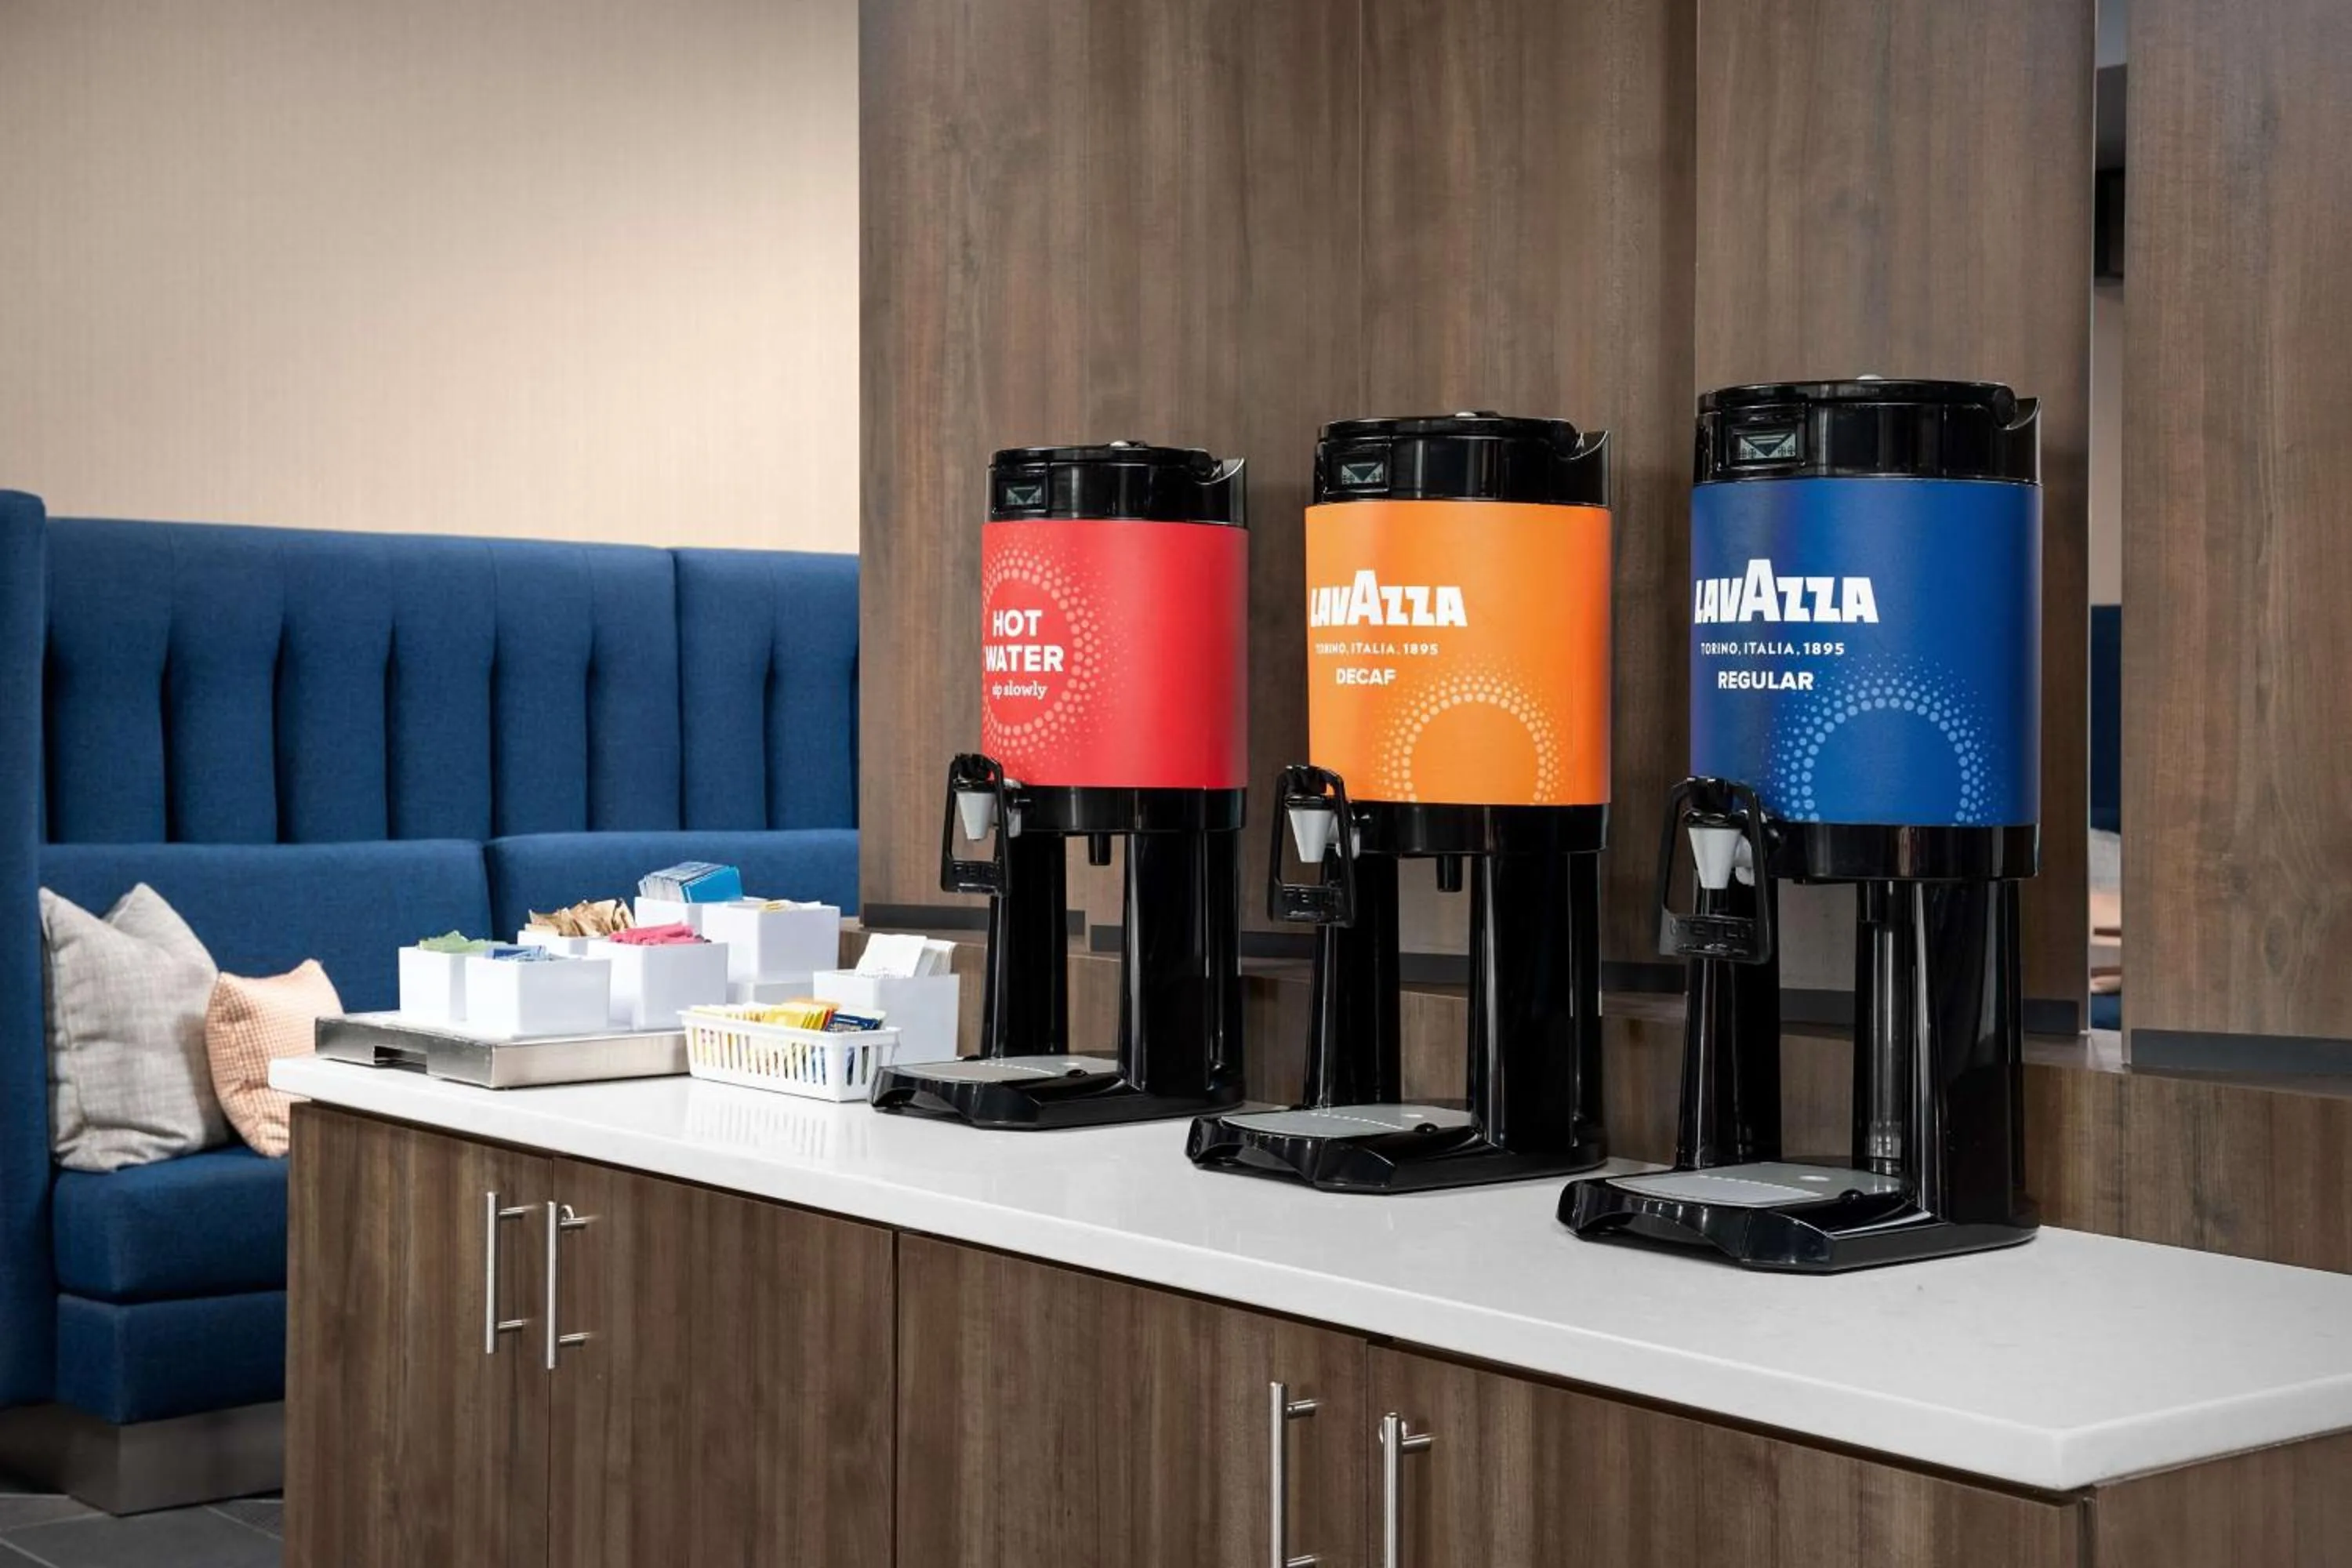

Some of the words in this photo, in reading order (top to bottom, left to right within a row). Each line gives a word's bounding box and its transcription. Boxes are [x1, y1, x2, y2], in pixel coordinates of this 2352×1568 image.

[1310, 569, 1468, 627] LAVAZZA
[1693, 558, 1880, 624] LAVAZZA
[993, 608, 1043, 637] HOT
[985, 644, 1065, 672] WATER
[1403, 643, 1439, 655] 1895
[1804, 642, 1846, 655] 1895
[1336, 667, 1396, 685] DECAF
[1717, 670, 1814, 691] REGULAR
[1004, 679, 1048, 700] slowly
